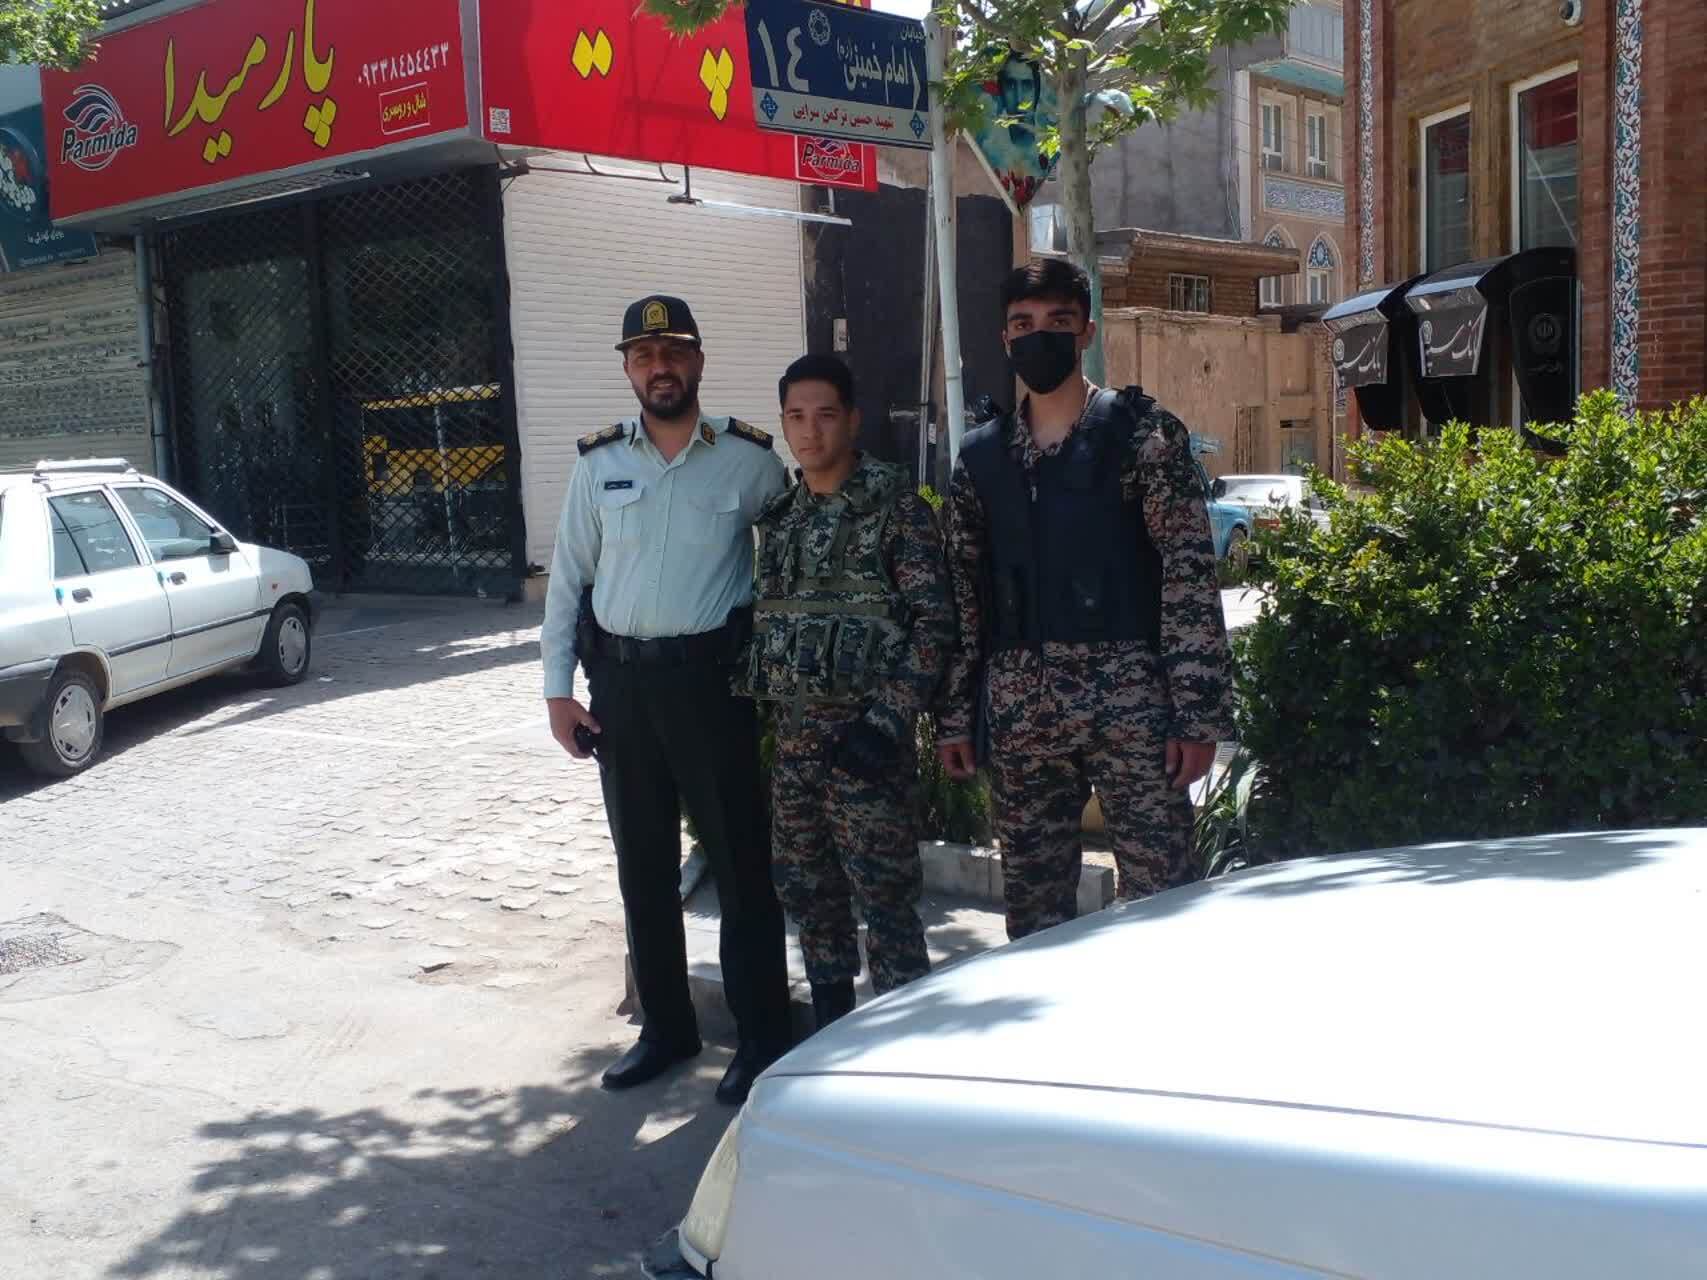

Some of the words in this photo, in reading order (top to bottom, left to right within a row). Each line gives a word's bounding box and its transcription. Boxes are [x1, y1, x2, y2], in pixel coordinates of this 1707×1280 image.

[164, 0, 336, 164] پارمیدا
[843, 41, 882, 91] خمینی
[884, 43, 908, 105] امام
[61, 120, 138, 165] Parmida
[849, 114, 873, 128] حسین
[875, 115, 895, 131] شهید
[802, 143, 860, 172] Parmida
